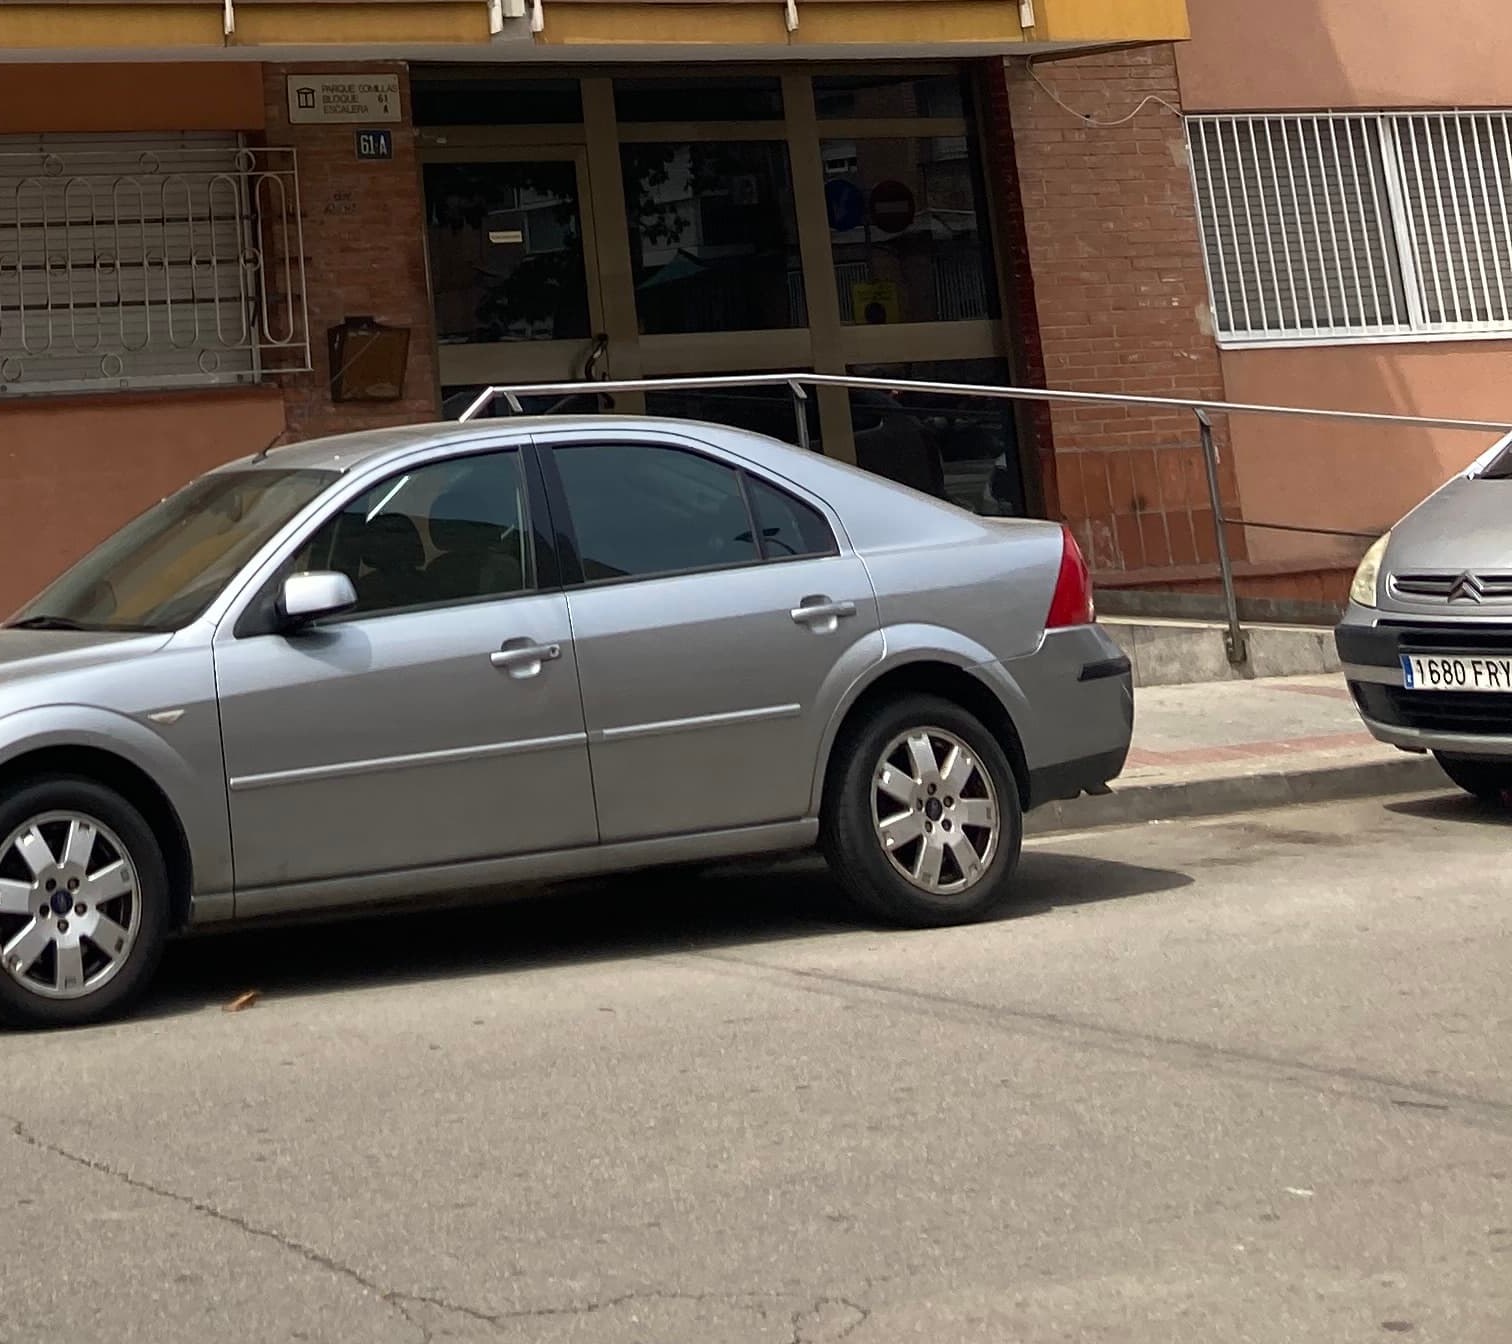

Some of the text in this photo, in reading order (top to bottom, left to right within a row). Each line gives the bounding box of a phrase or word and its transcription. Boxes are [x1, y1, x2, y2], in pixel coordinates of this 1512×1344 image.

[321, 83, 398, 93] PARQUE COMILLAS
[322, 95, 388, 104] BLOQUE 61
[323, 104, 369, 114] ESCALERA
[1416, 659, 1512, 687] 1680 FRY
